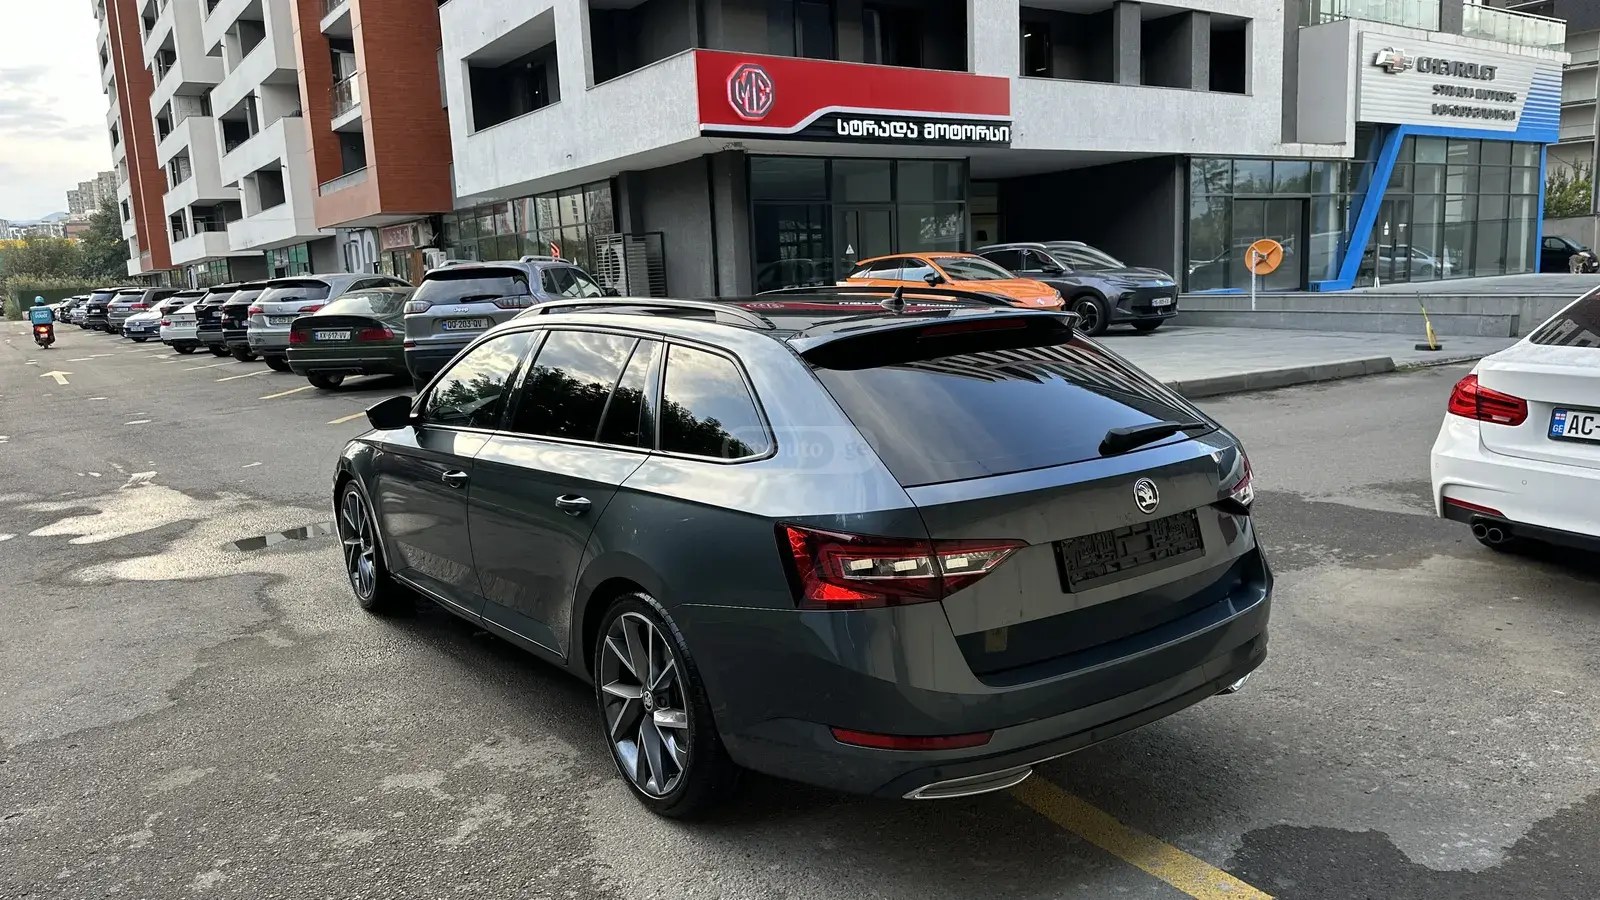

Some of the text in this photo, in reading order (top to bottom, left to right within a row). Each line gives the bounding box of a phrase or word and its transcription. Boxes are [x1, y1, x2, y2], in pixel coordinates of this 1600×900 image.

[1416, 57, 1498, 80] CHEVROLET
[733, 67, 773, 115] MG
[837, 118, 1009, 142] სტრადა მოტორსი
[1552, 424, 1564, 433] GE
